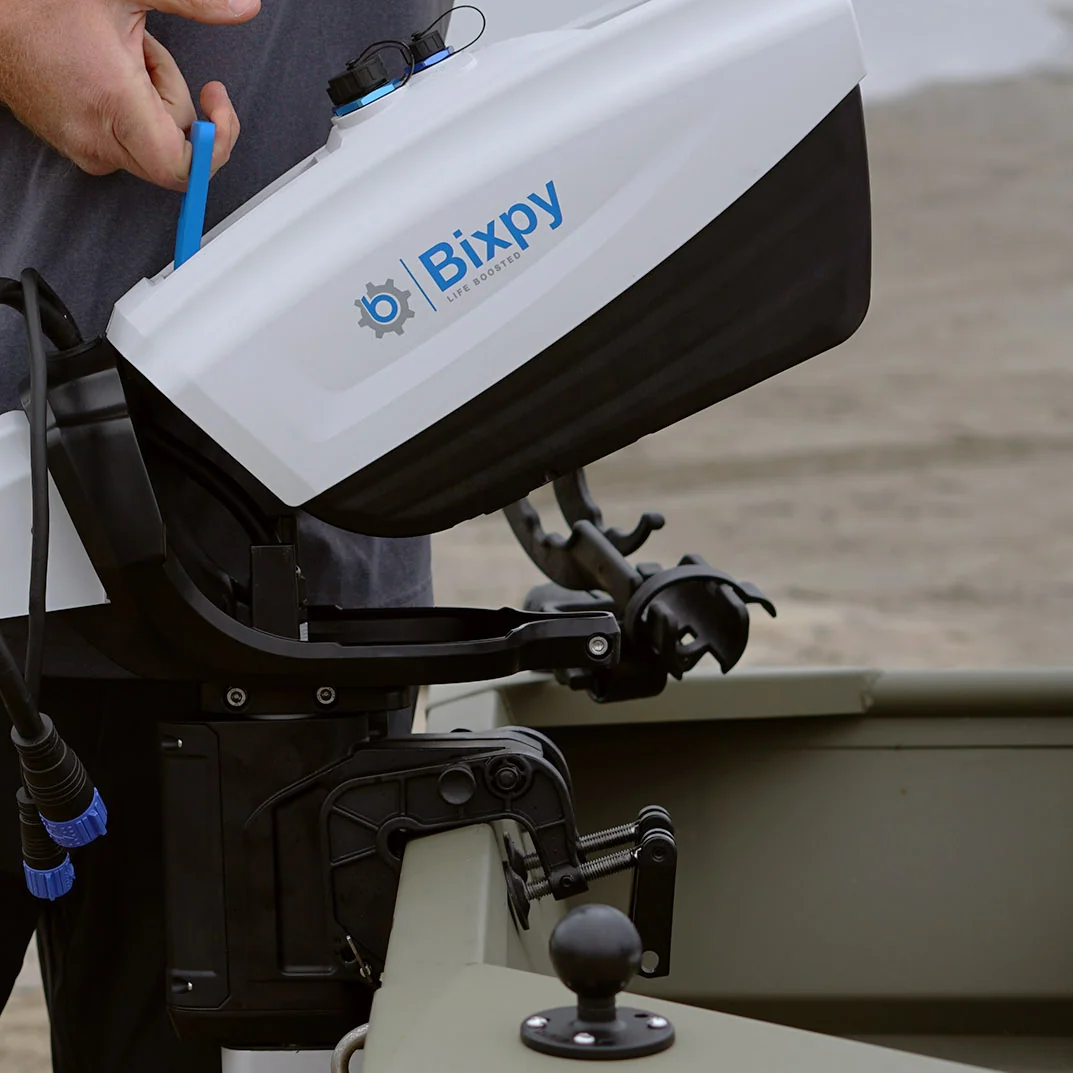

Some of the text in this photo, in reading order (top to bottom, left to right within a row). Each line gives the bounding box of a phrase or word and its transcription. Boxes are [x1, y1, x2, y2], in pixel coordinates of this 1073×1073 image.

[418, 180, 563, 292] Bixpy
[446, 251, 522, 303] LIFE BOOSTED
